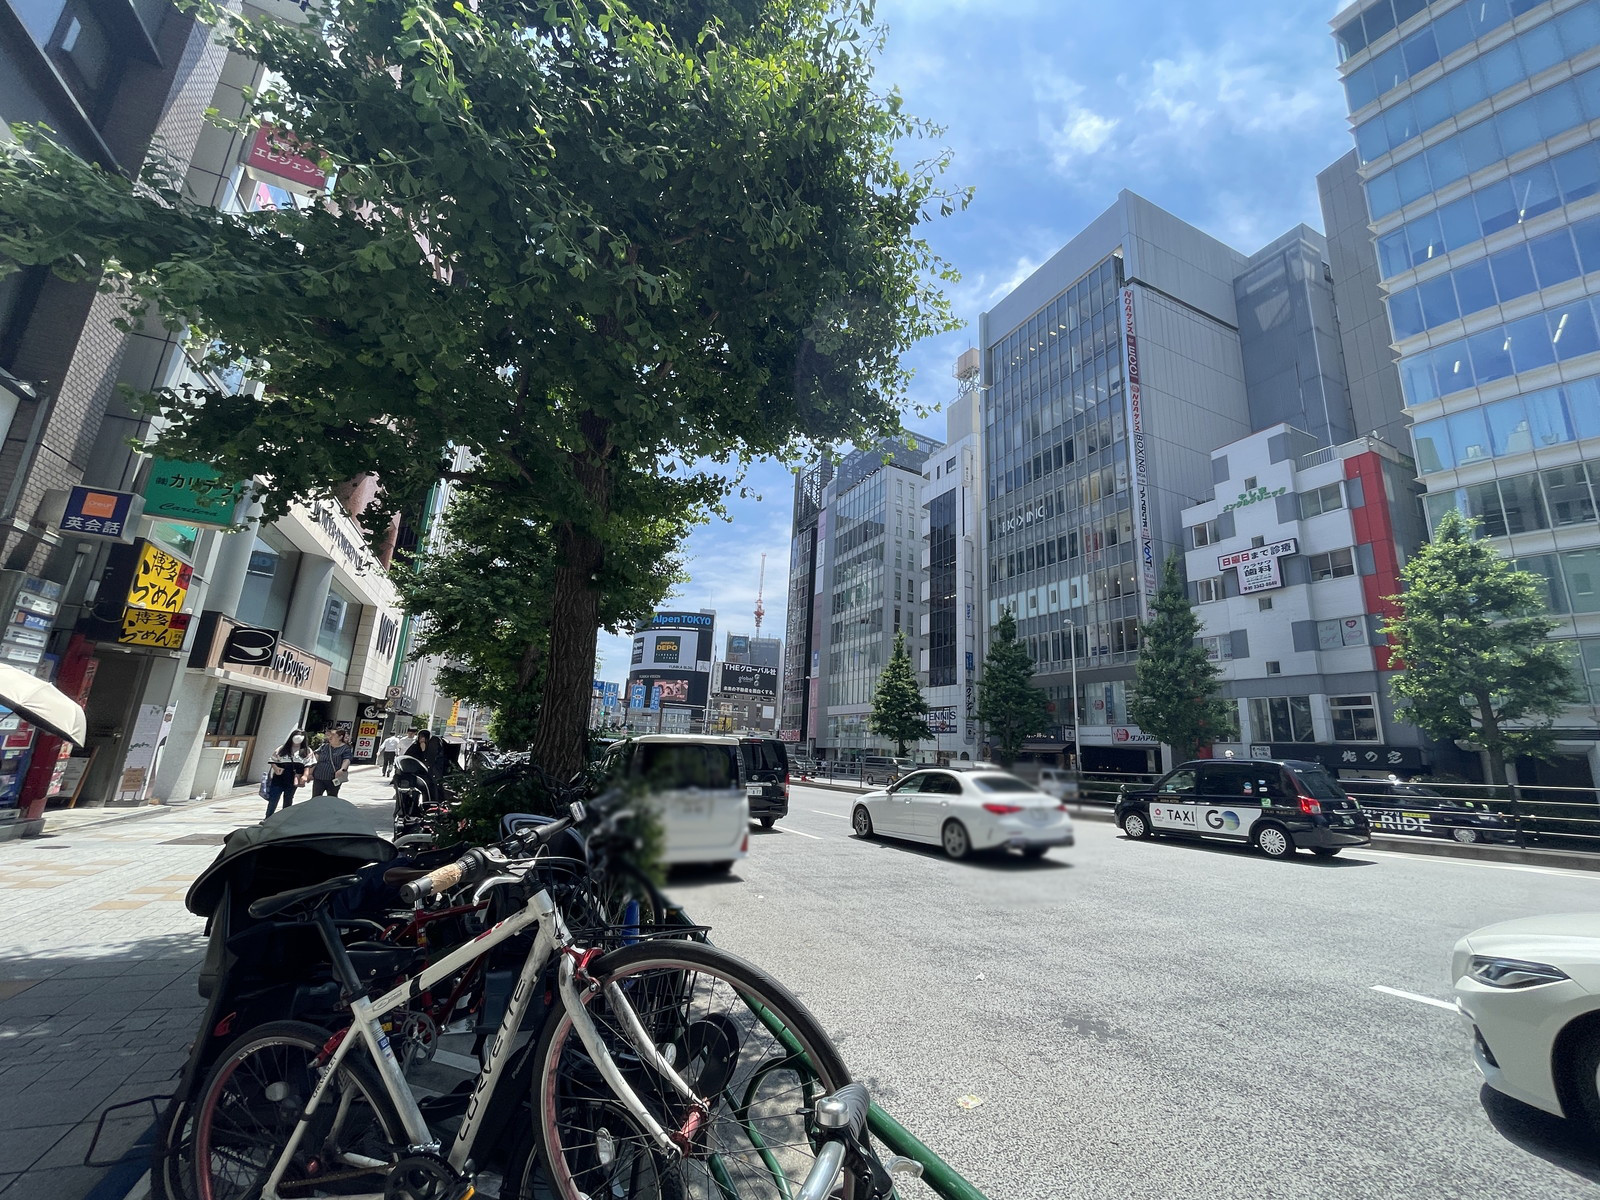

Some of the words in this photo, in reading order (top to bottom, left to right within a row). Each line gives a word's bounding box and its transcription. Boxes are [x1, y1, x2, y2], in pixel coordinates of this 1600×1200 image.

[1128, 346, 1138, 375] ECC
[1136, 434, 1146, 473] BOXING
[64, 515, 121, 536] 英会話
[1222, 542, 1292, 567] 日曜日まで診療
[150, 551, 179, 583] 博多
[1244, 564, 1273, 578] 歯科
[135, 611, 169, 627] 博多
[652, 614, 680, 625] Alpen
[681, 615, 711, 626] TOKYO
[724, 663, 777, 676] THEグローバル社
[360, 727, 376, 735] 180
[1166, 809, 1195, 823] TAXI
